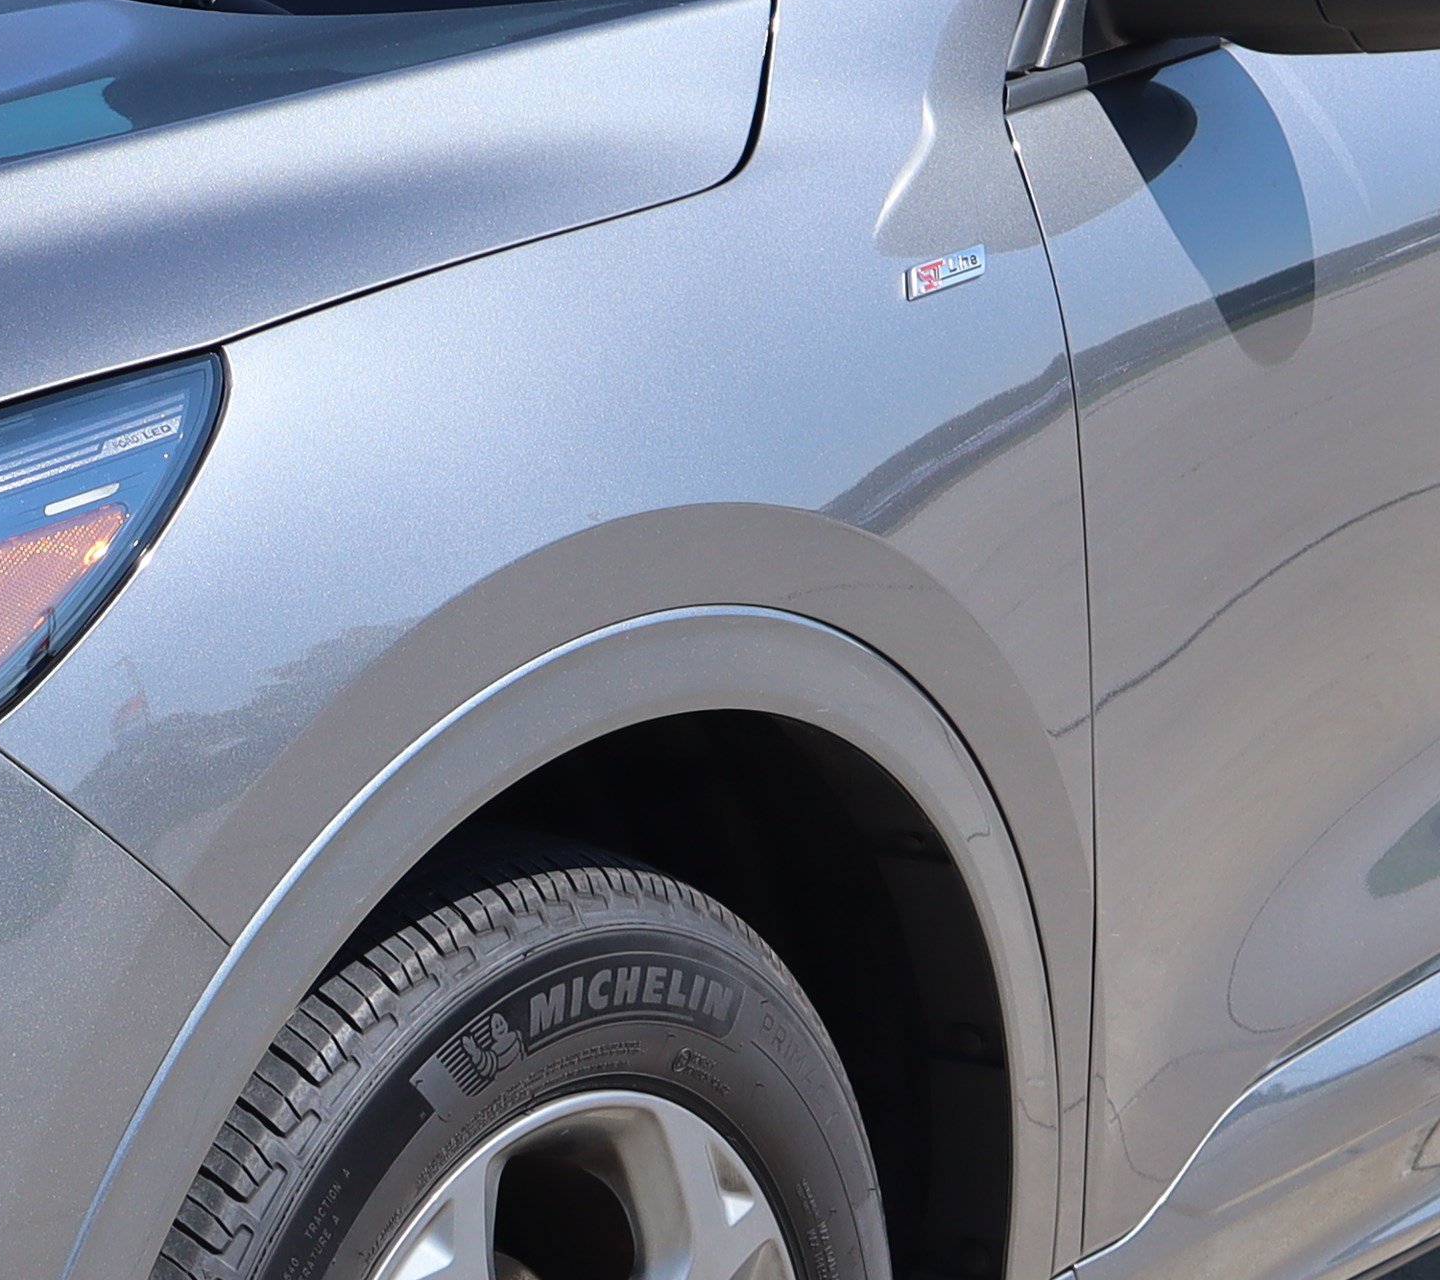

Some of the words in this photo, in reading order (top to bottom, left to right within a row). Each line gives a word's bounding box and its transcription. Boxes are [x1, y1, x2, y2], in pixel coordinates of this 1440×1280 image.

[142, 424, 172, 440] LED
[529, 965, 736, 1038] MICHELIN
[304, 1183, 343, 1239] TRACTION
